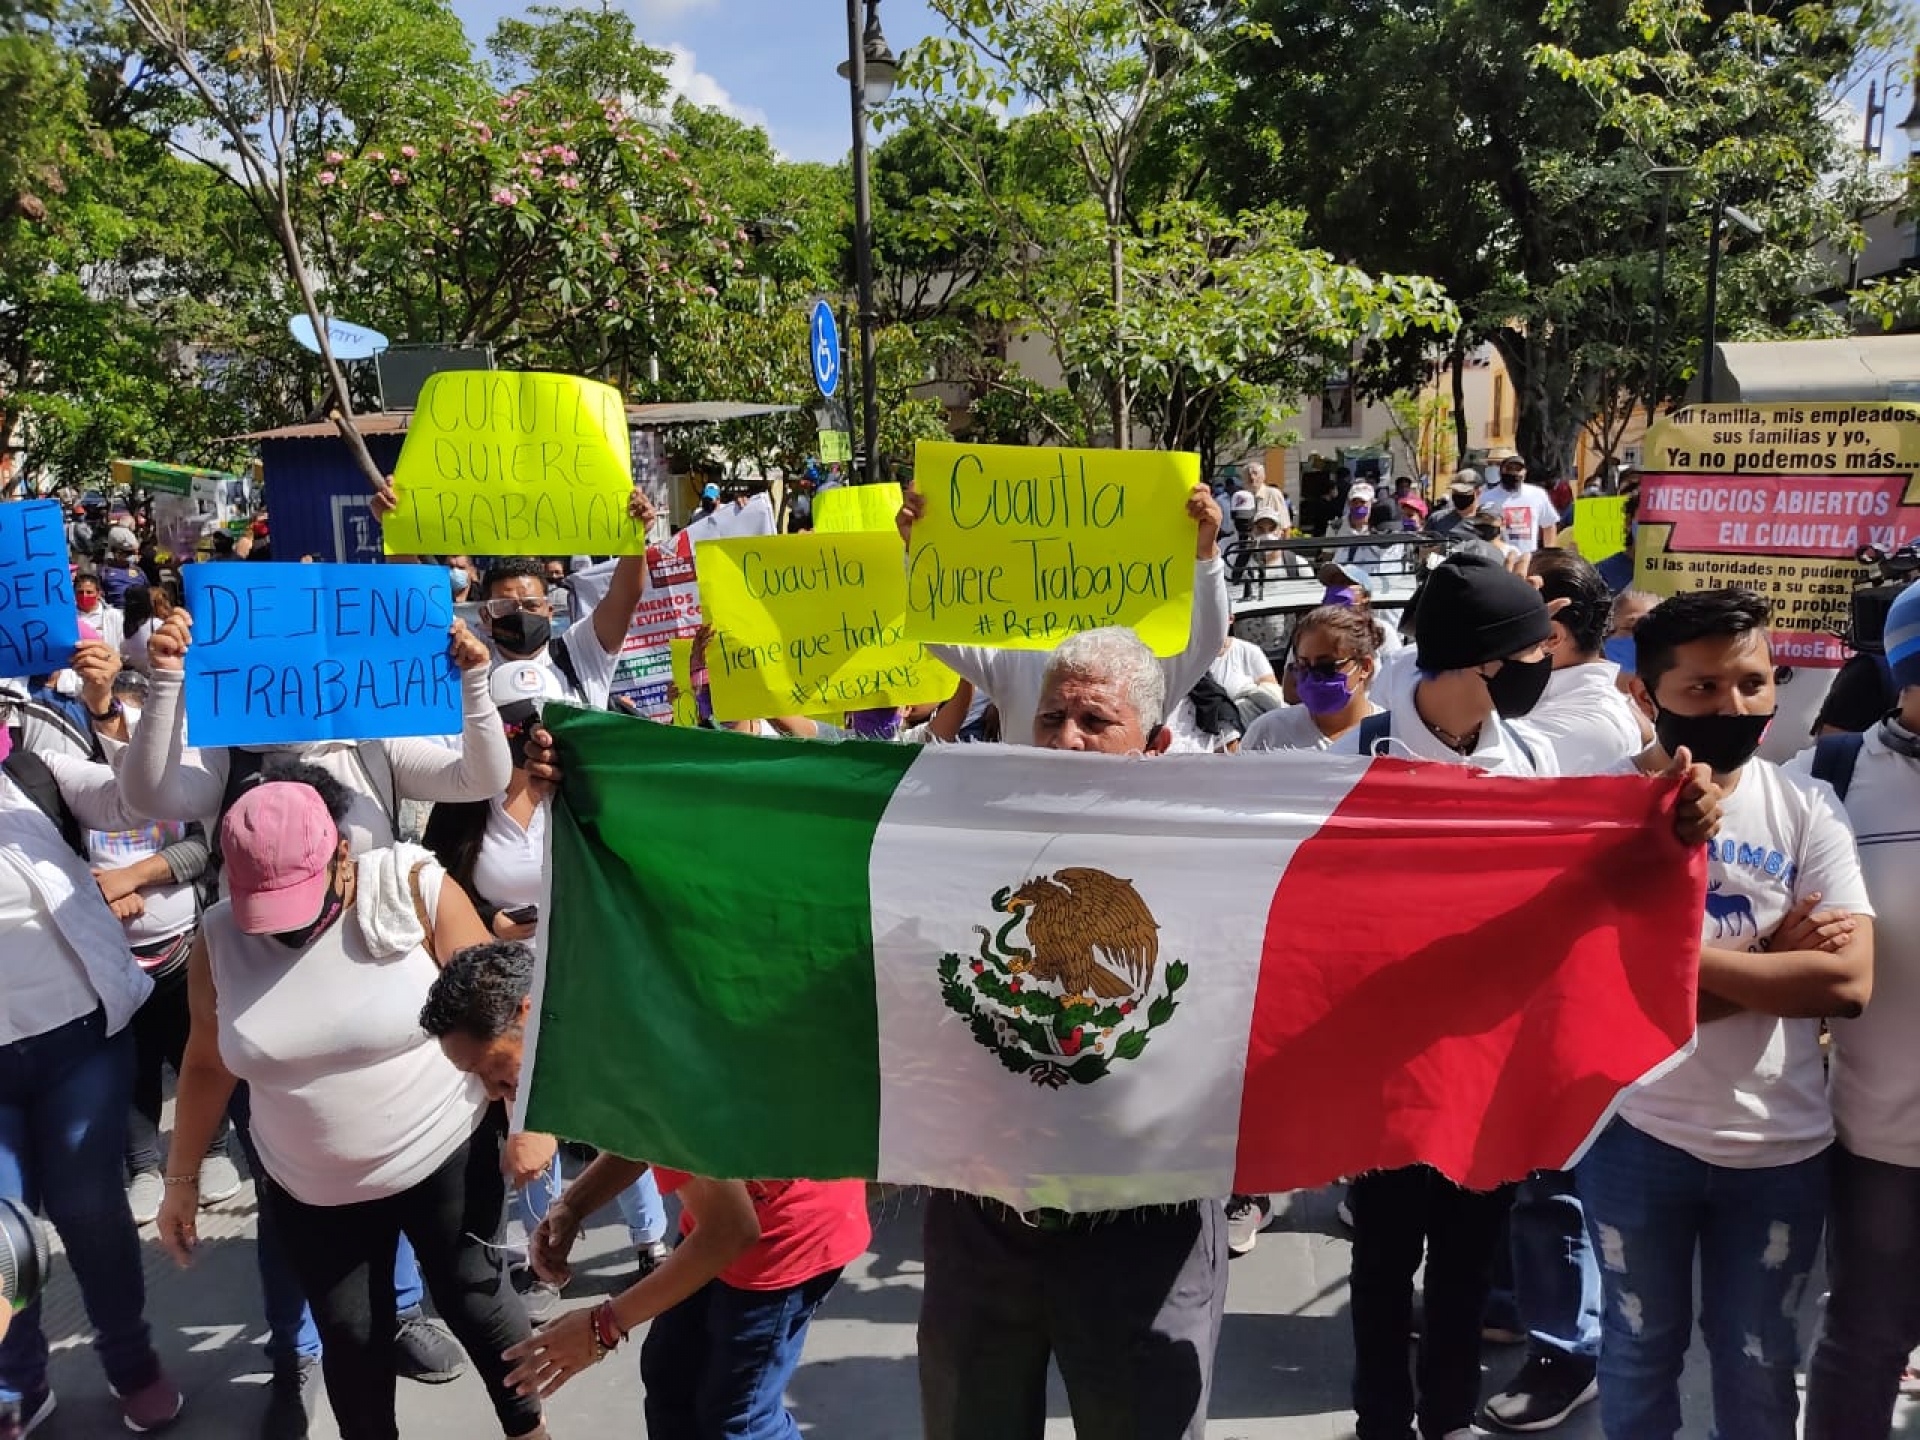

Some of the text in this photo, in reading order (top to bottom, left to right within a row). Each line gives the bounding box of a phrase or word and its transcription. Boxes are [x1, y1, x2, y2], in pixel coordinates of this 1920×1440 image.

[430, 377, 631, 444] CUAUTLA
[1673, 409, 1693, 426] Mi
[1700, 408, 1767, 426] familia,
[1773, 407, 1803, 423] mis
[434, 437, 599, 487] QUIERE
[1667, 448, 1920, 473] Ya no podemos más...
[1712, 428, 1871, 447] sus familias y yo,
[950, 452, 1126, 530] Cuautla
[1646, 486, 1891, 516] ¡NEGOCIOS ABIERTOS
[395, 486, 638, 546] TRABAJAR
[1718, 521, 1750, 545] EN
[1755, 522, 1858, 549] CUAUTLA
[743, 547, 865, 599] Cuautla
[908, 536, 1174, 621] Quiere Trabajar
[1645, 557, 1658, 571] Si
[1663, 557, 1683, 571] las
[1688, 559, 1773, 576] autoridades
[1778, 563, 1796, 577] no
[1695, 579, 1704, 588] a
[1709, 575, 1722, 589] la
[1772, 580, 1781, 592] a
[1786, 581, 1802, 593] su
[717, 629, 782, 678] Tiene
[789, 631, 830, 676] que
[198, 651, 455, 720] TRABAJAR
